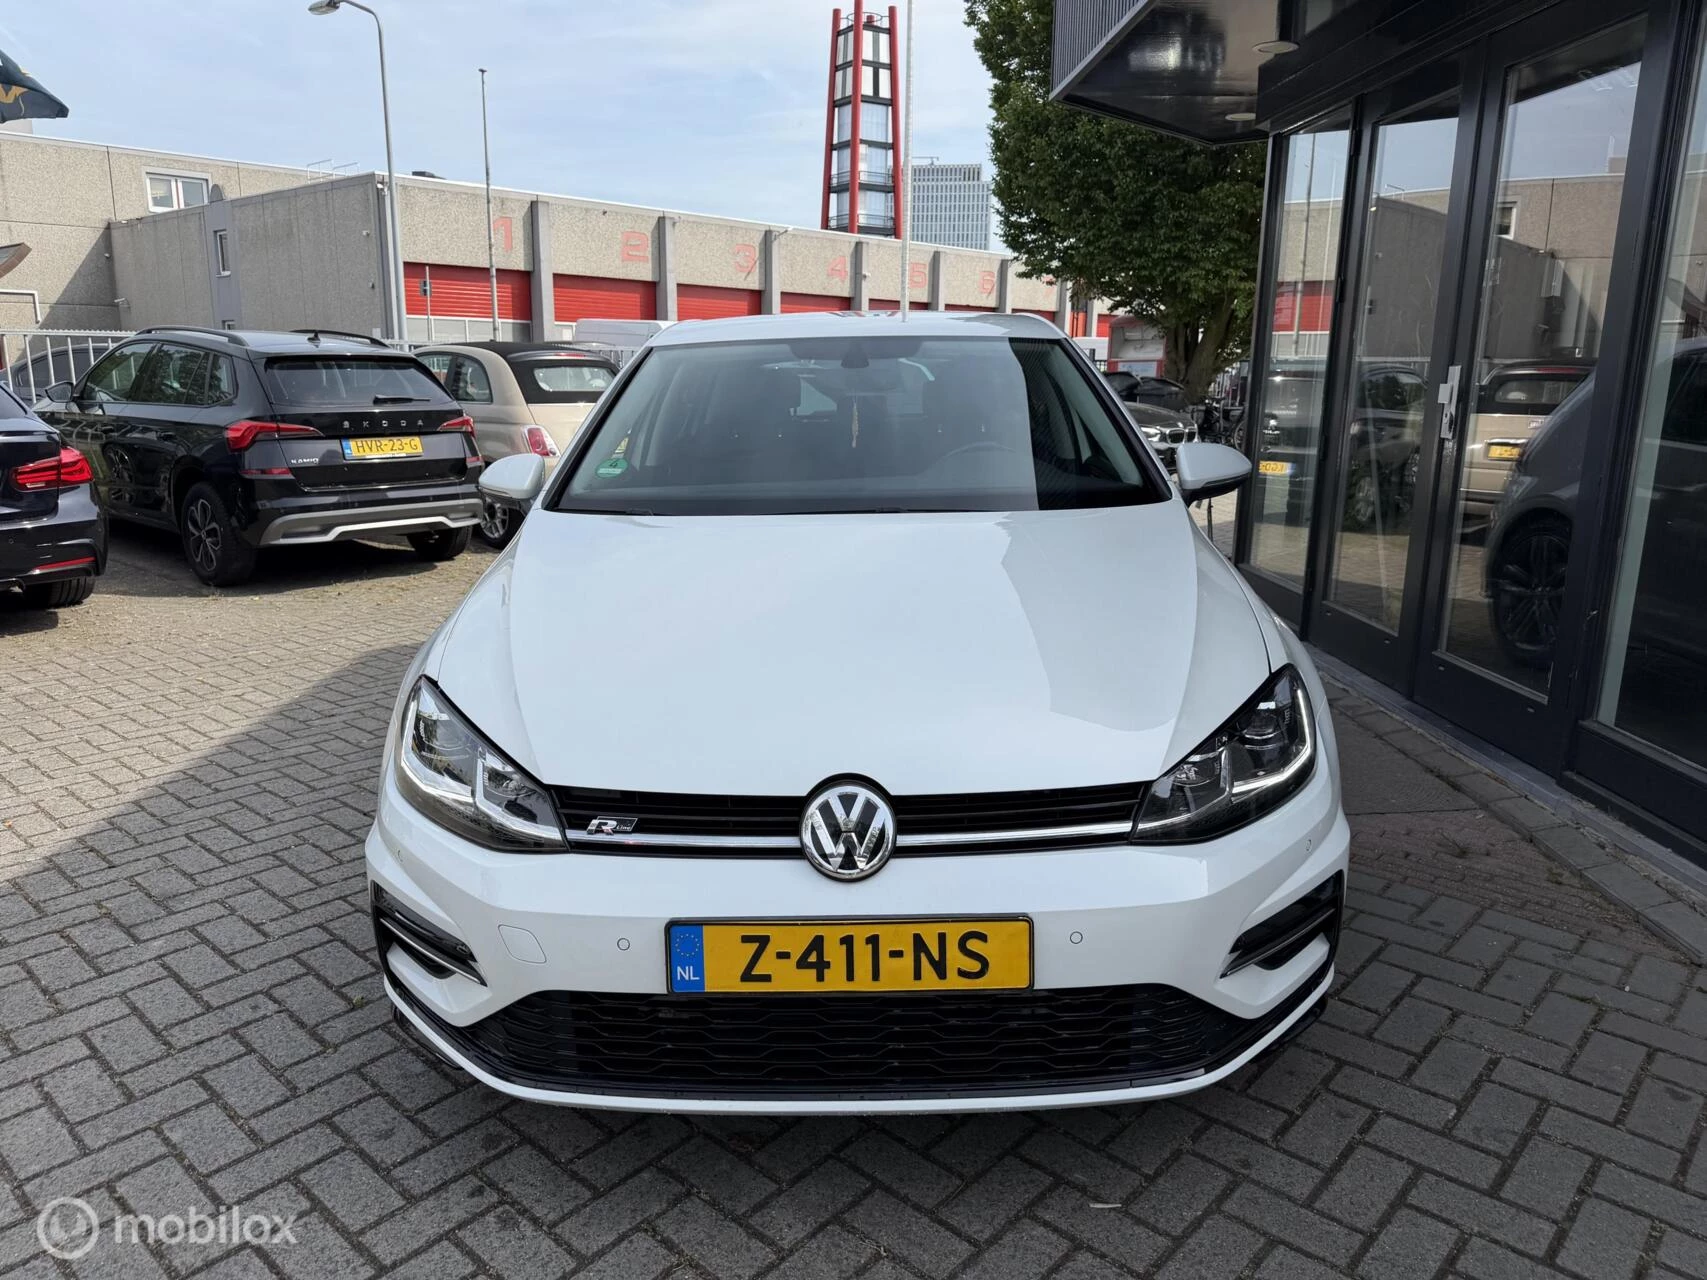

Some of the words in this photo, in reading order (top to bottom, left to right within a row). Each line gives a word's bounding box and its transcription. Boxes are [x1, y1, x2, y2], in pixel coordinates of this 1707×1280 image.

[492, 217, 512, 251] 1
[620, 231, 649, 263] 2
[733, 243, 757, 273] 3
[827, 256, 848, 283] 4
[909, 262, 927, 288] 5
[979, 271, 995, 295] 6
[355, 438, 419, 453] HVR-23-G
[739, 931, 990, 983] Z-411-NS
[676, 966, 700, 981] NL
